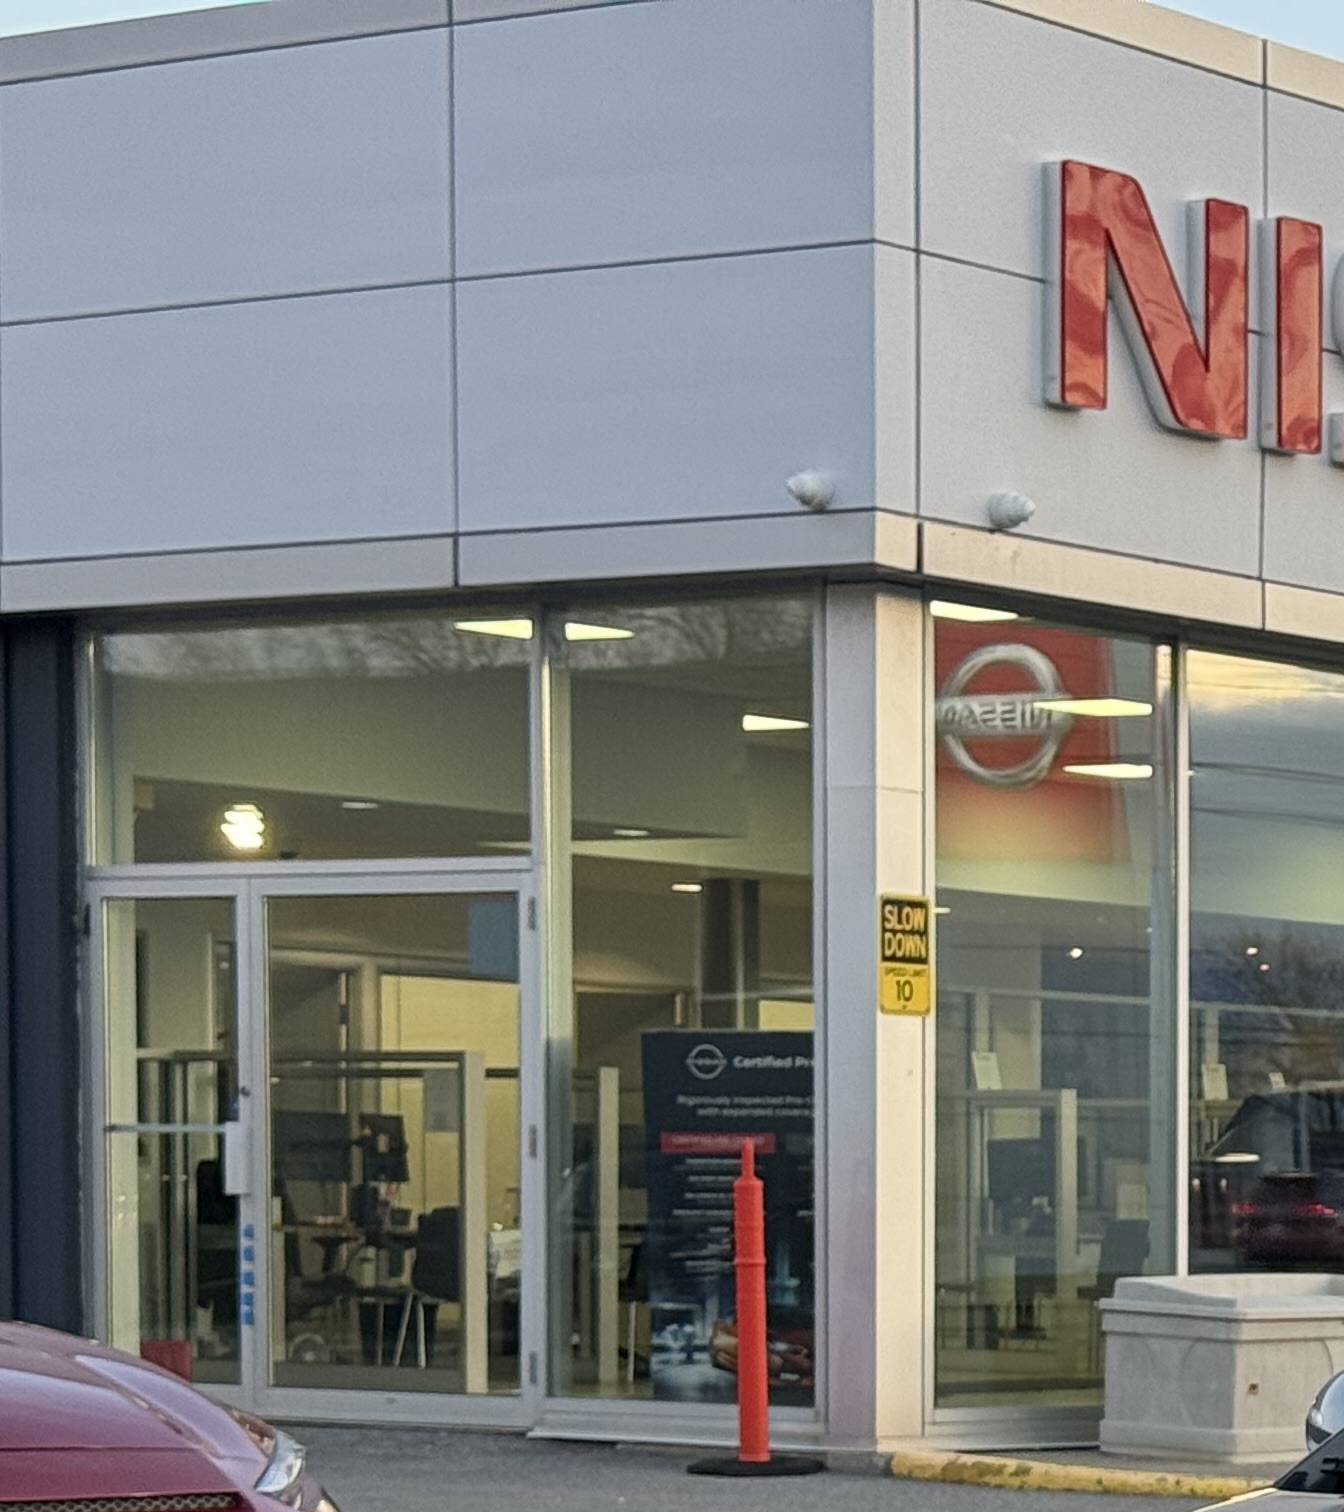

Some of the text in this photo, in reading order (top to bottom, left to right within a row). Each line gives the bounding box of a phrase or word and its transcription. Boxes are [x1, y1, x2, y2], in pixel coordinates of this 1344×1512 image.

[883, 904, 925, 932] SLOW
[883, 932, 926, 959] DOWN
[895, 979, 914, 1002] 10
